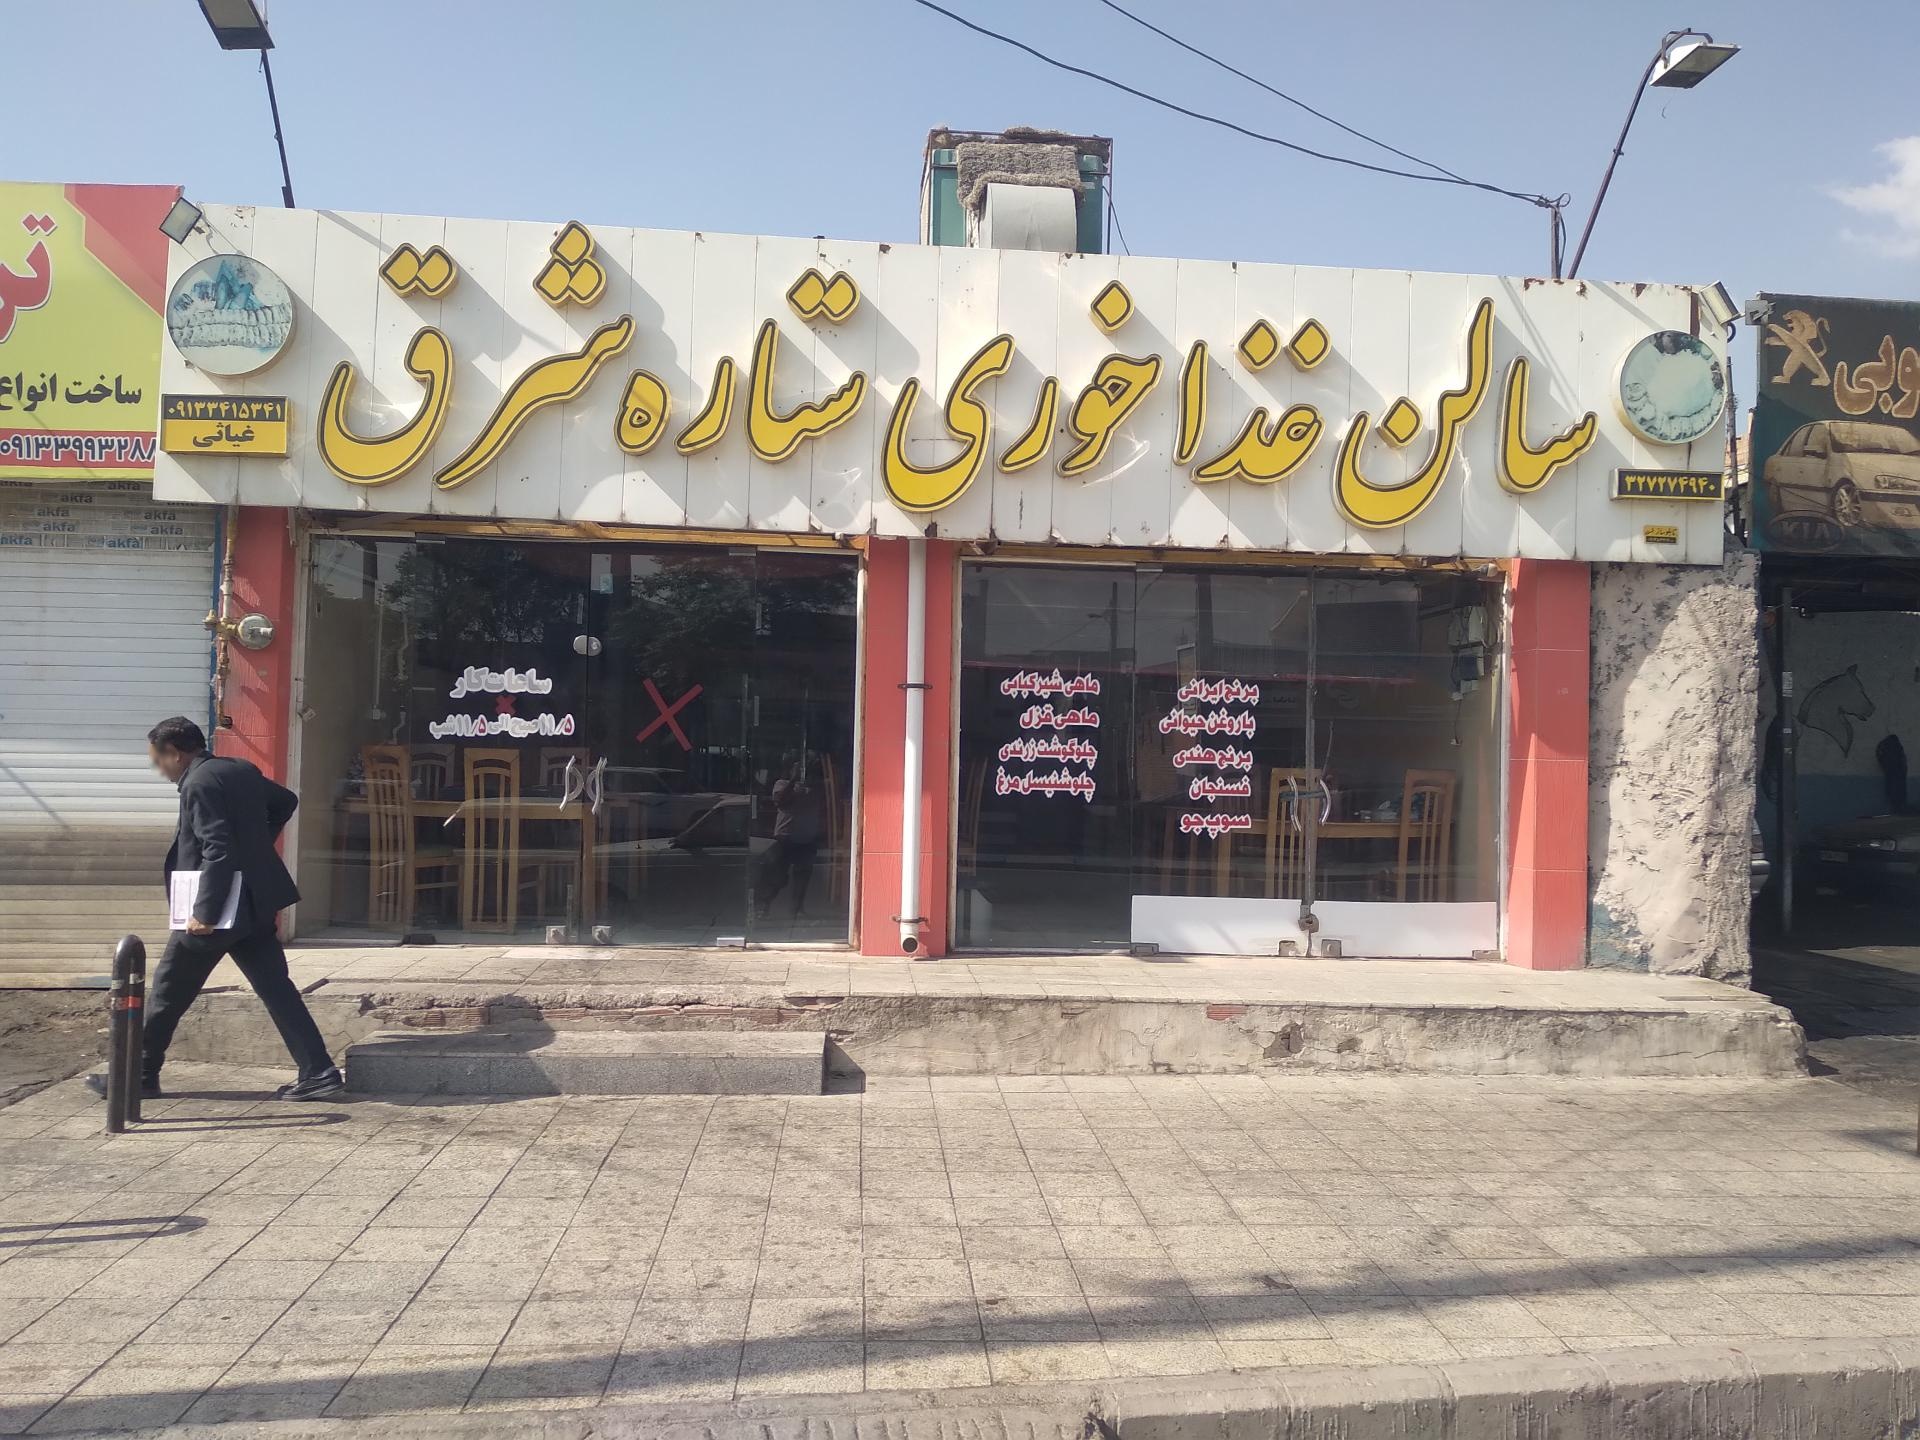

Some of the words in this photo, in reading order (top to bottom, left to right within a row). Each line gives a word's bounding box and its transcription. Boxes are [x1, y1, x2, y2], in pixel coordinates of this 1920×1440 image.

[316, 219, 636, 490] شرق
[612, 267, 868, 463] ستاره
[0, 371, 57, 412] انواع
[64, 374, 142, 404] ساخت
[168, 400, 282, 419] ۰۹۱۳۳۴۱۵۳۴۱
[1330, 297, 1600, 531] سالن
[192, 422, 255, 448] غیاثی
[43, 521, 76, 532] akfa
[144, 511, 177, 522] akfa
[107, 537, 140, 548] akfa
[150, 524, 184, 536] akfa
[449, 665, 489, 698] کار
[484, 667, 552, 694] ساعات
[1063, 672, 1100, 697] ماهی
[1178, 678, 1226, 704] ایرانی
[1223, 678, 1260, 706] برنج
[1019, 703, 1054, 729] قزل
[1053, 706, 1100, 730] ماهی
[1159, 708, 1207, 737] حیوانی
[999, 737, 1037, 762] زرندی
[1173, 744, 1218, 768] هندی
[1217, 745, 1253, 772] برنج
[995, 765, 1022, 795] مرغ
[1189, 775, 1251, 803] فسنجان
[1179, 813, 1205, 836] جو
[1204, 813, 1252, 840] سوپ
